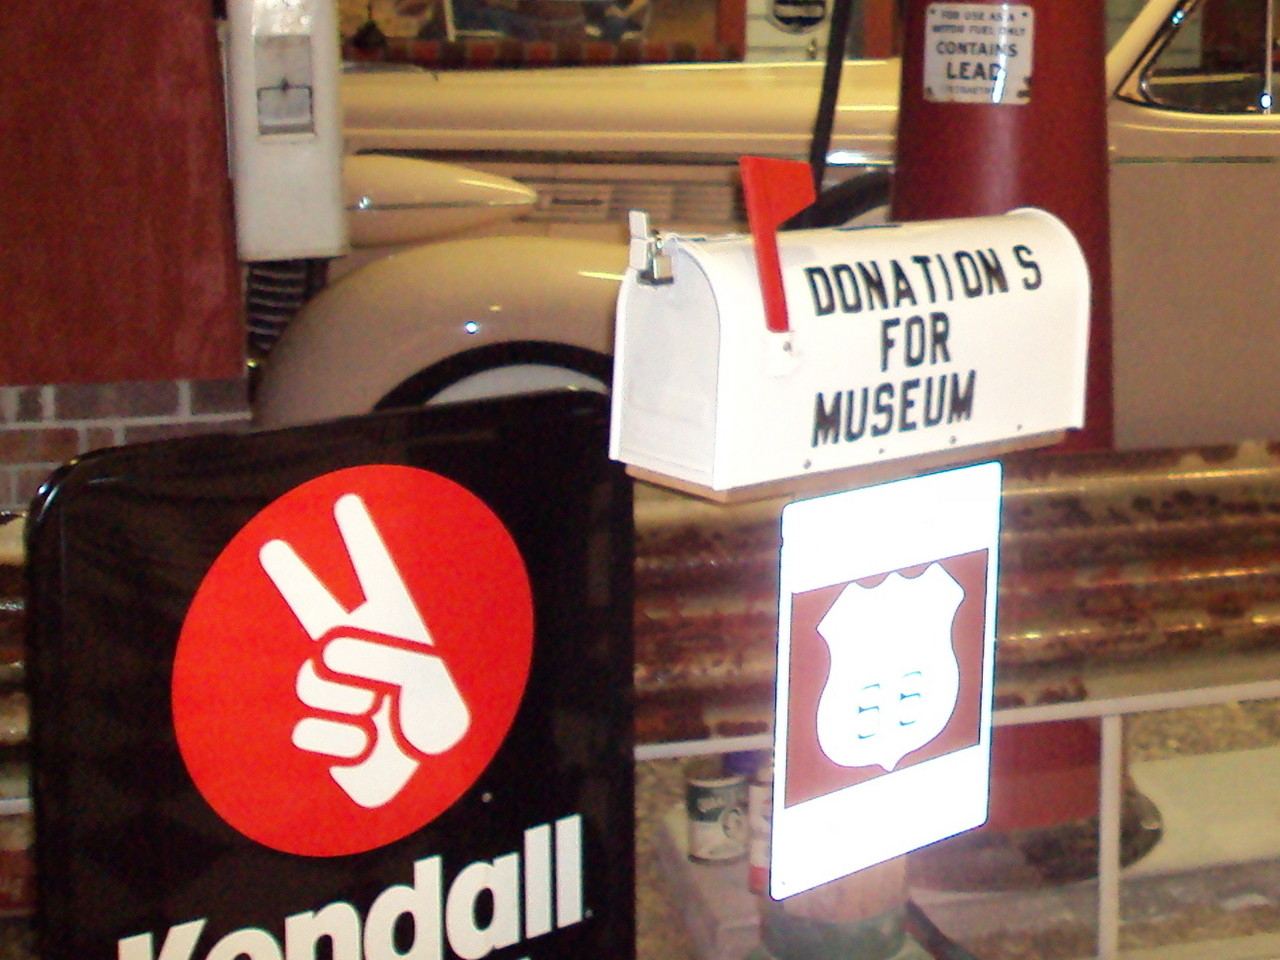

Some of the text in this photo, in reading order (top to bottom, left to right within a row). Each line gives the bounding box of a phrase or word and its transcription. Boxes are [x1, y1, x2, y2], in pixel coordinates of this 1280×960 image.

[935, 41, 1018, 57] CONTAINS
[946, 61, 1006, 82] LEAD
[879, 311, 952, 373] FOR
[810, 368, 978, 448] MUSEUM
